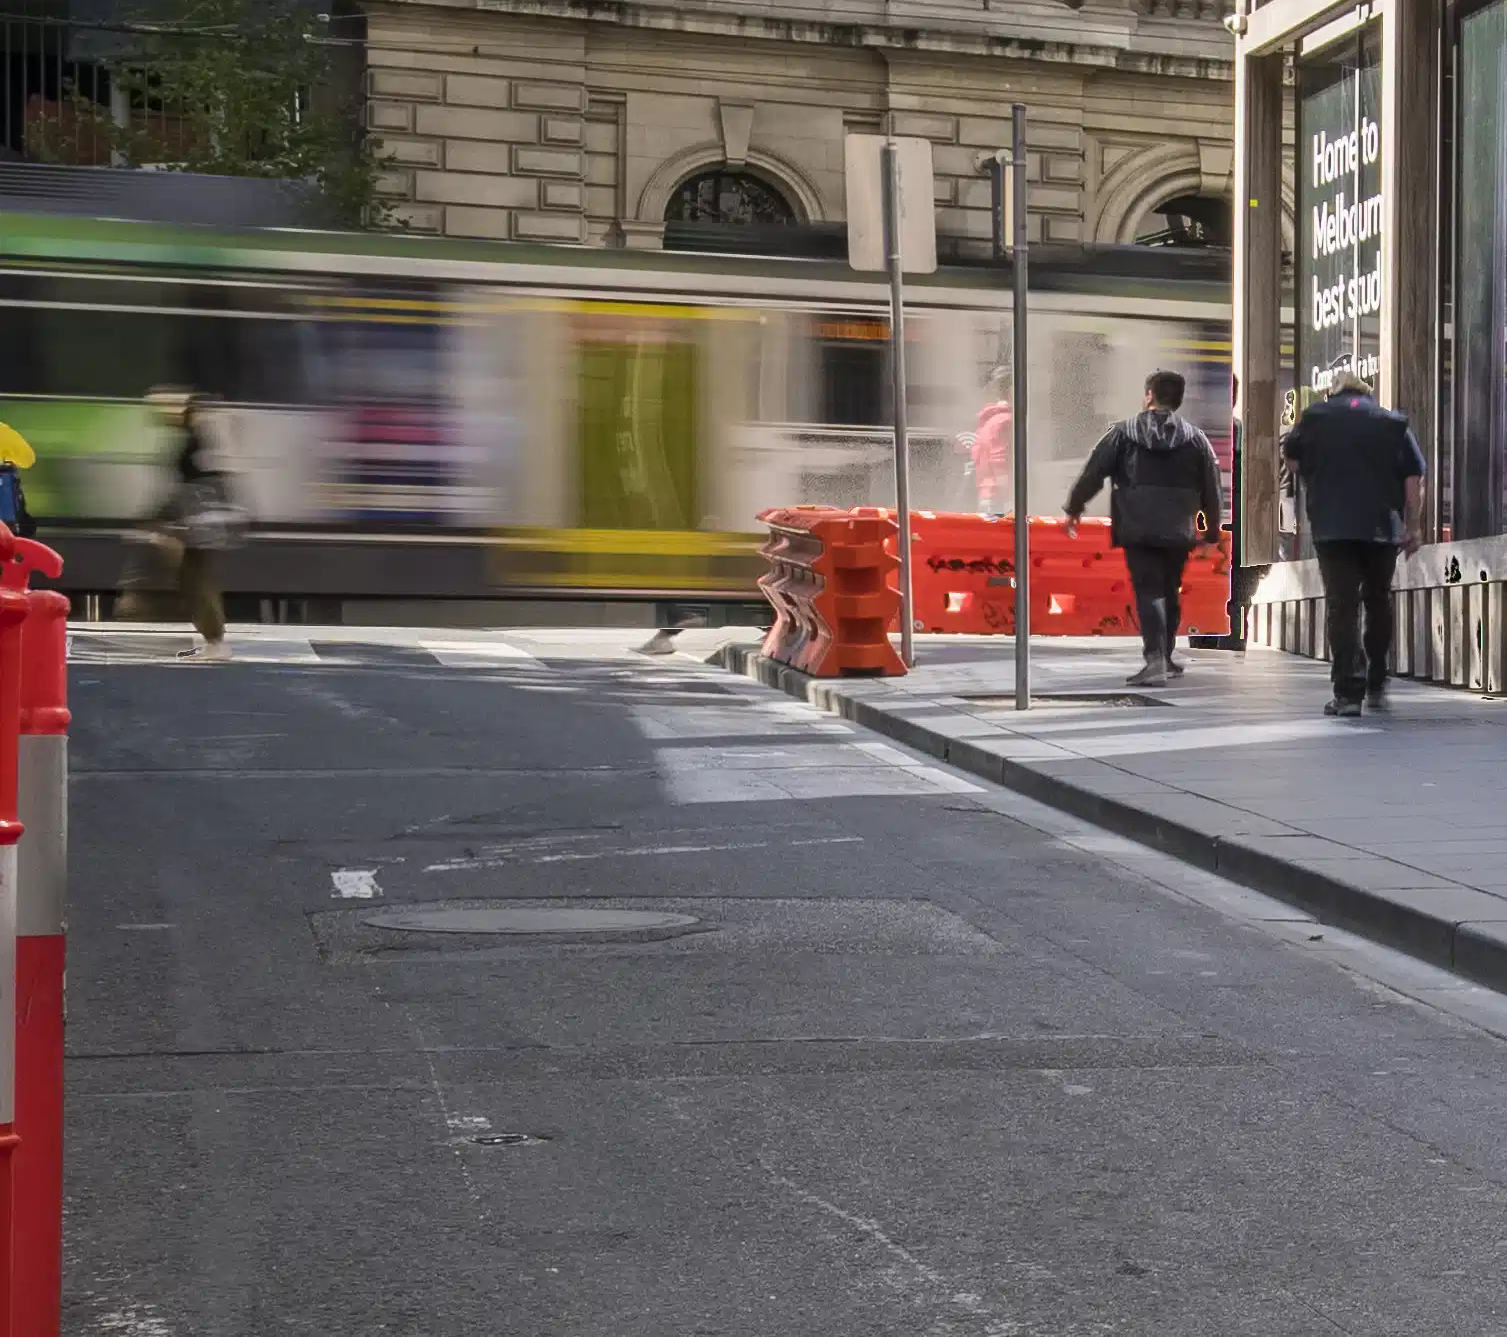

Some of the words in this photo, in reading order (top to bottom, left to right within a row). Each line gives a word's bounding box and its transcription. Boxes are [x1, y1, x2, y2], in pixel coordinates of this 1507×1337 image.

[1313, 131, 1358, 188] Home
[1361, 117, 1379, 165] to
[1312, 274, 1345, 331] best
